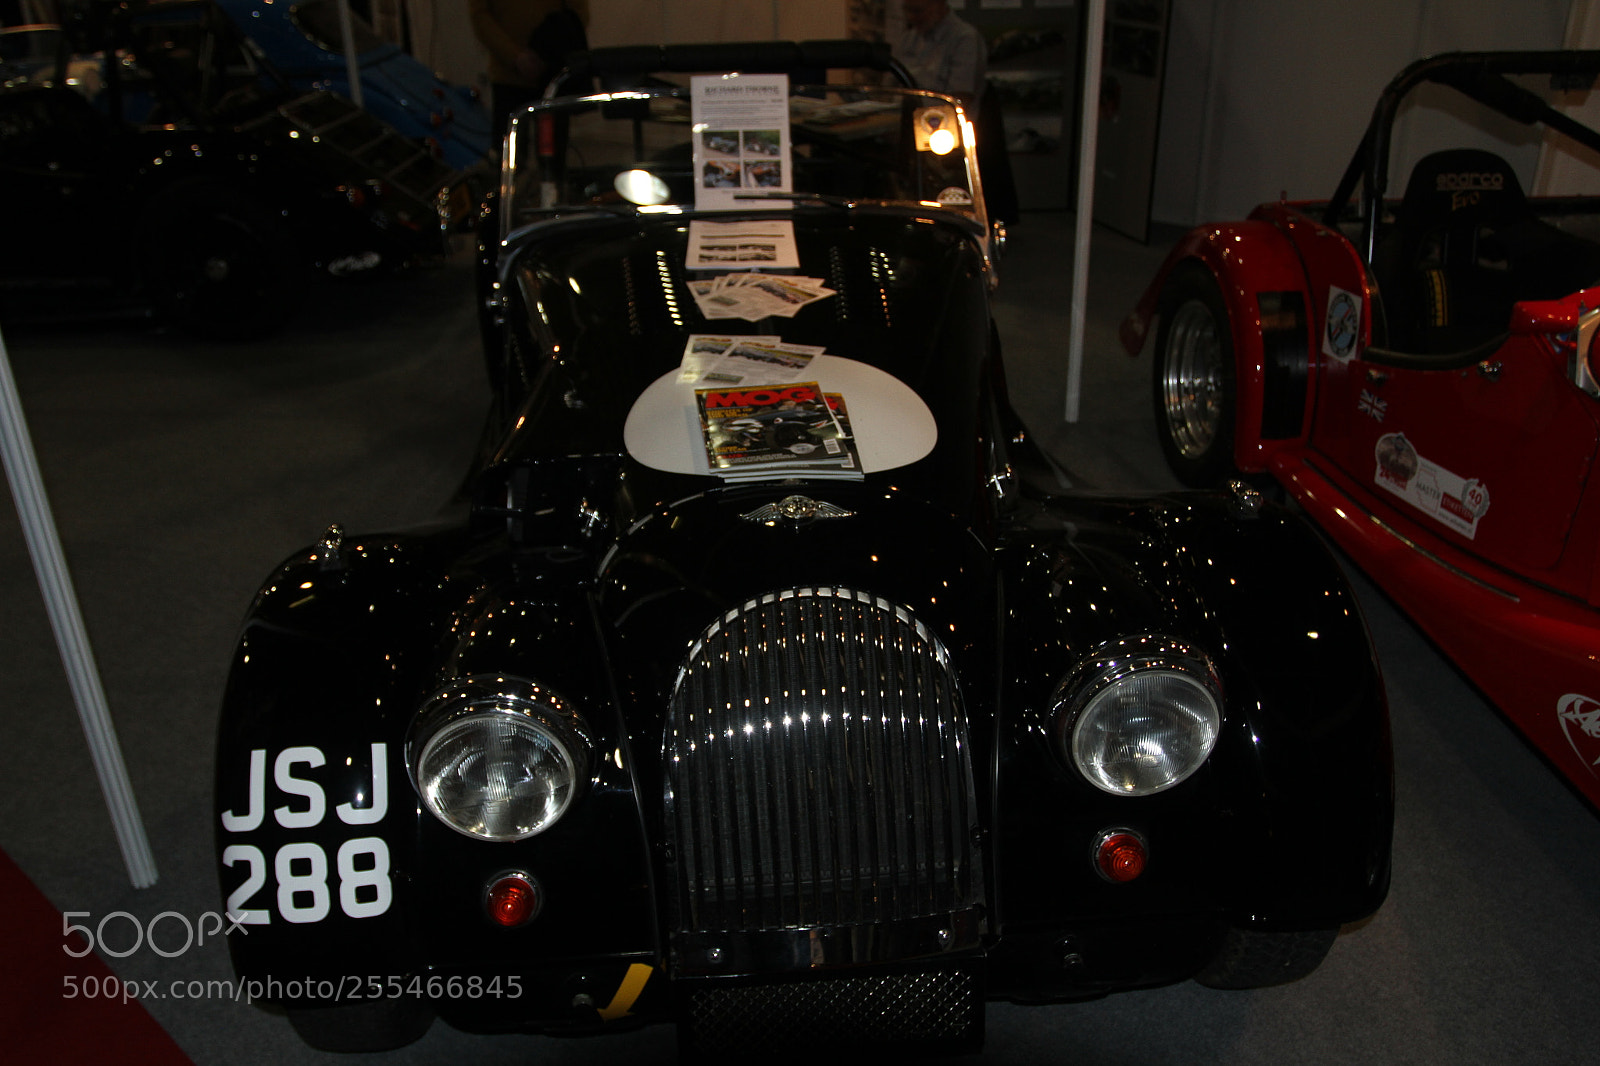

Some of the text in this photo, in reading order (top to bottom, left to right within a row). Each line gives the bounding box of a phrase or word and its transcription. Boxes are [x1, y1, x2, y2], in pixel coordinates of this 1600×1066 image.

[1436, 172, 1504, 188] sparco
[705, 386, 816, 408] MOG
[1415, 480, 1441, 500] MASTER
[1468, 489, 1482, 505] 40
[221, 742, 389, 833] JSJ
[222, 836, 393, 925] 288
